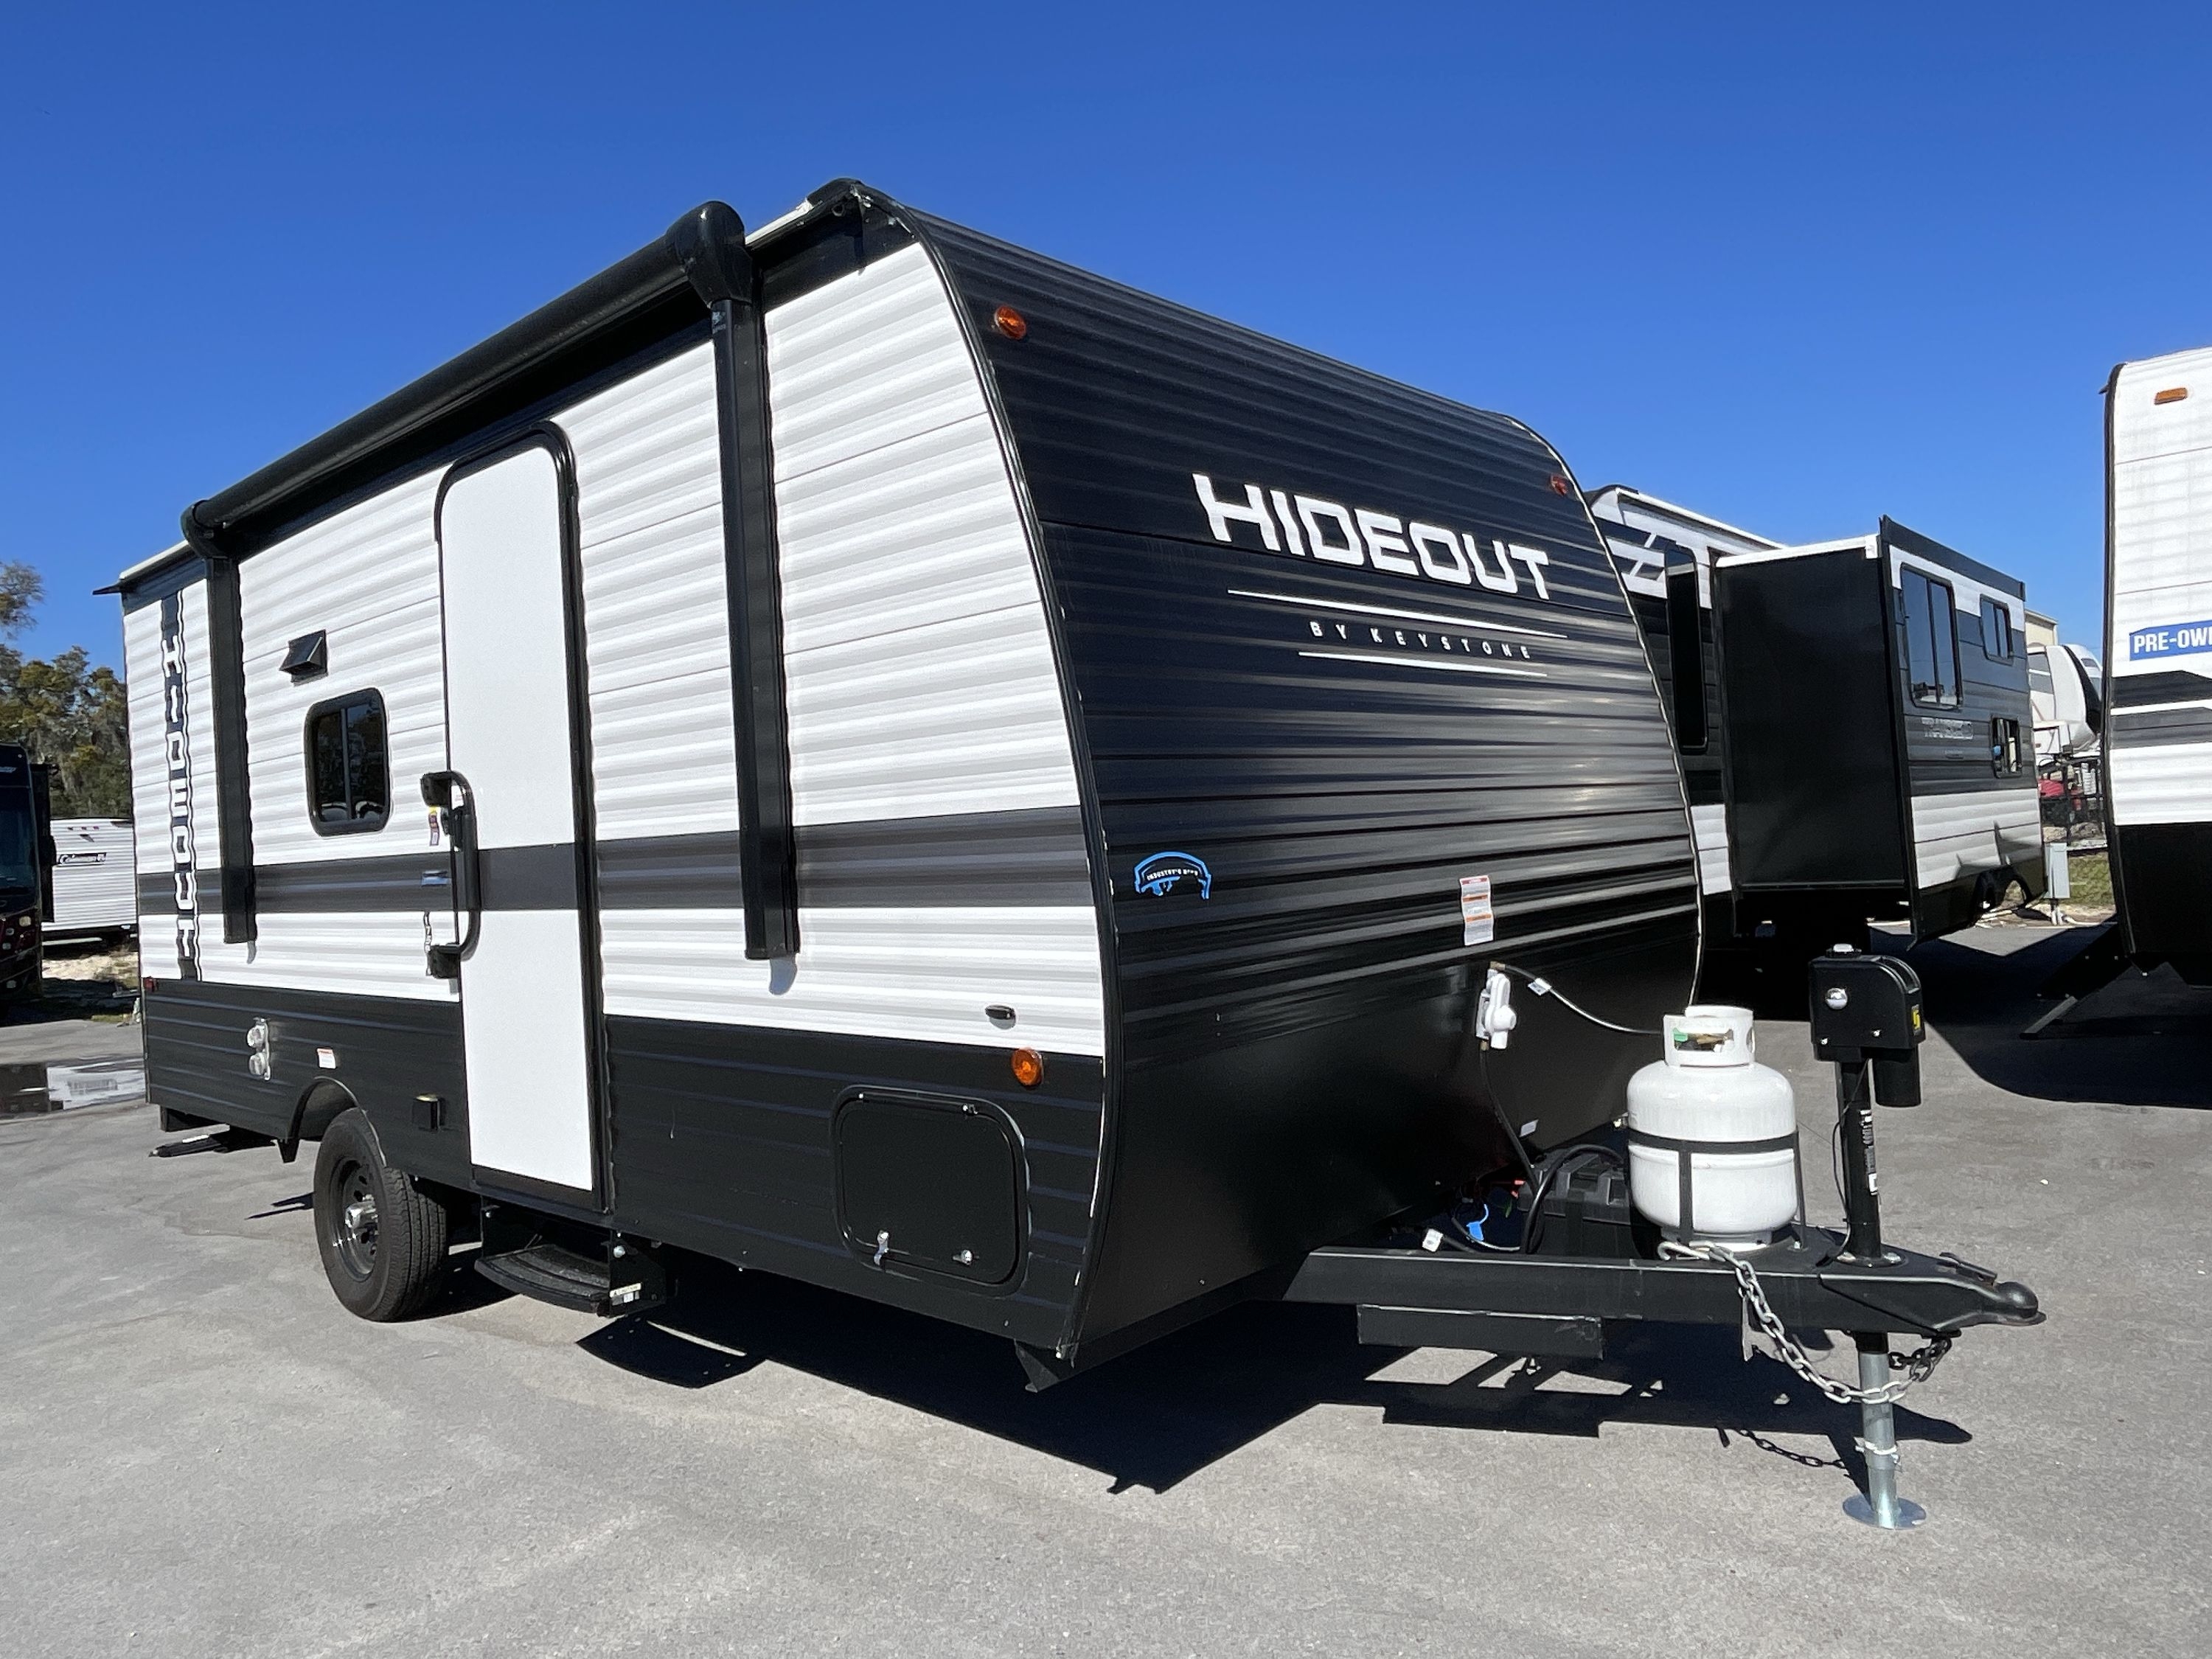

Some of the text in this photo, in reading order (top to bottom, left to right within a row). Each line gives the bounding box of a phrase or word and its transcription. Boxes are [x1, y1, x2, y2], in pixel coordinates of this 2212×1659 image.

[1192, 473, 1549, 599] HIDEOUT
[1310, 622, 1531, 658] BY KEYSTONE
[161, 635, 195, 959] HIDEOUT
